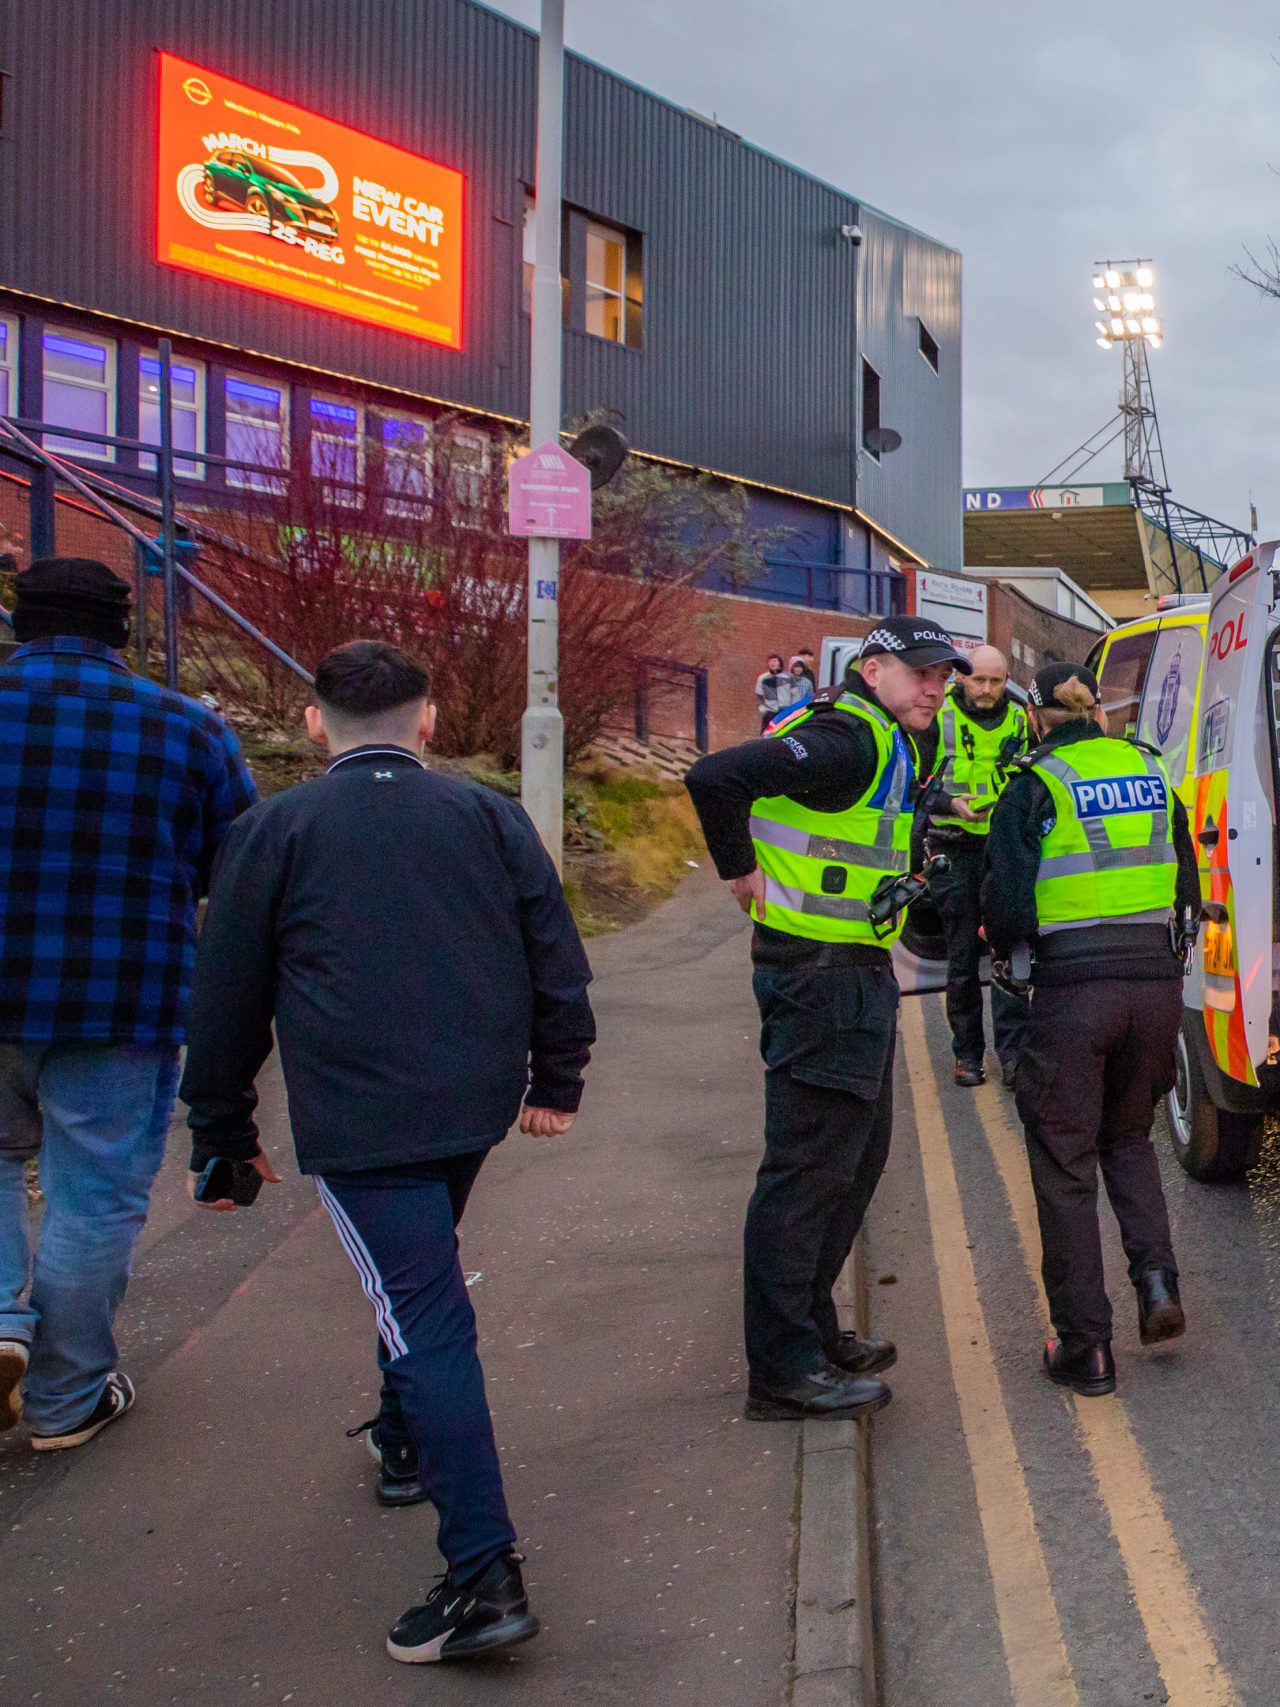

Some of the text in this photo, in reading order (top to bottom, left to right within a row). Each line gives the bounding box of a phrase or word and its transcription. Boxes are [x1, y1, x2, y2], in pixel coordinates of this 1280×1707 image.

[202, 132, 267, 159] MARCH
[352, 175, 444, 226] NEW CAR
[352, 194, 445, 248] EVENT
[271, 219, 346, 265] 25-REG
[965, 641, 984, 650] GAM
[1207, 612, 1248, 668] POL
[1076, 780, 1165, 812] POLICE
